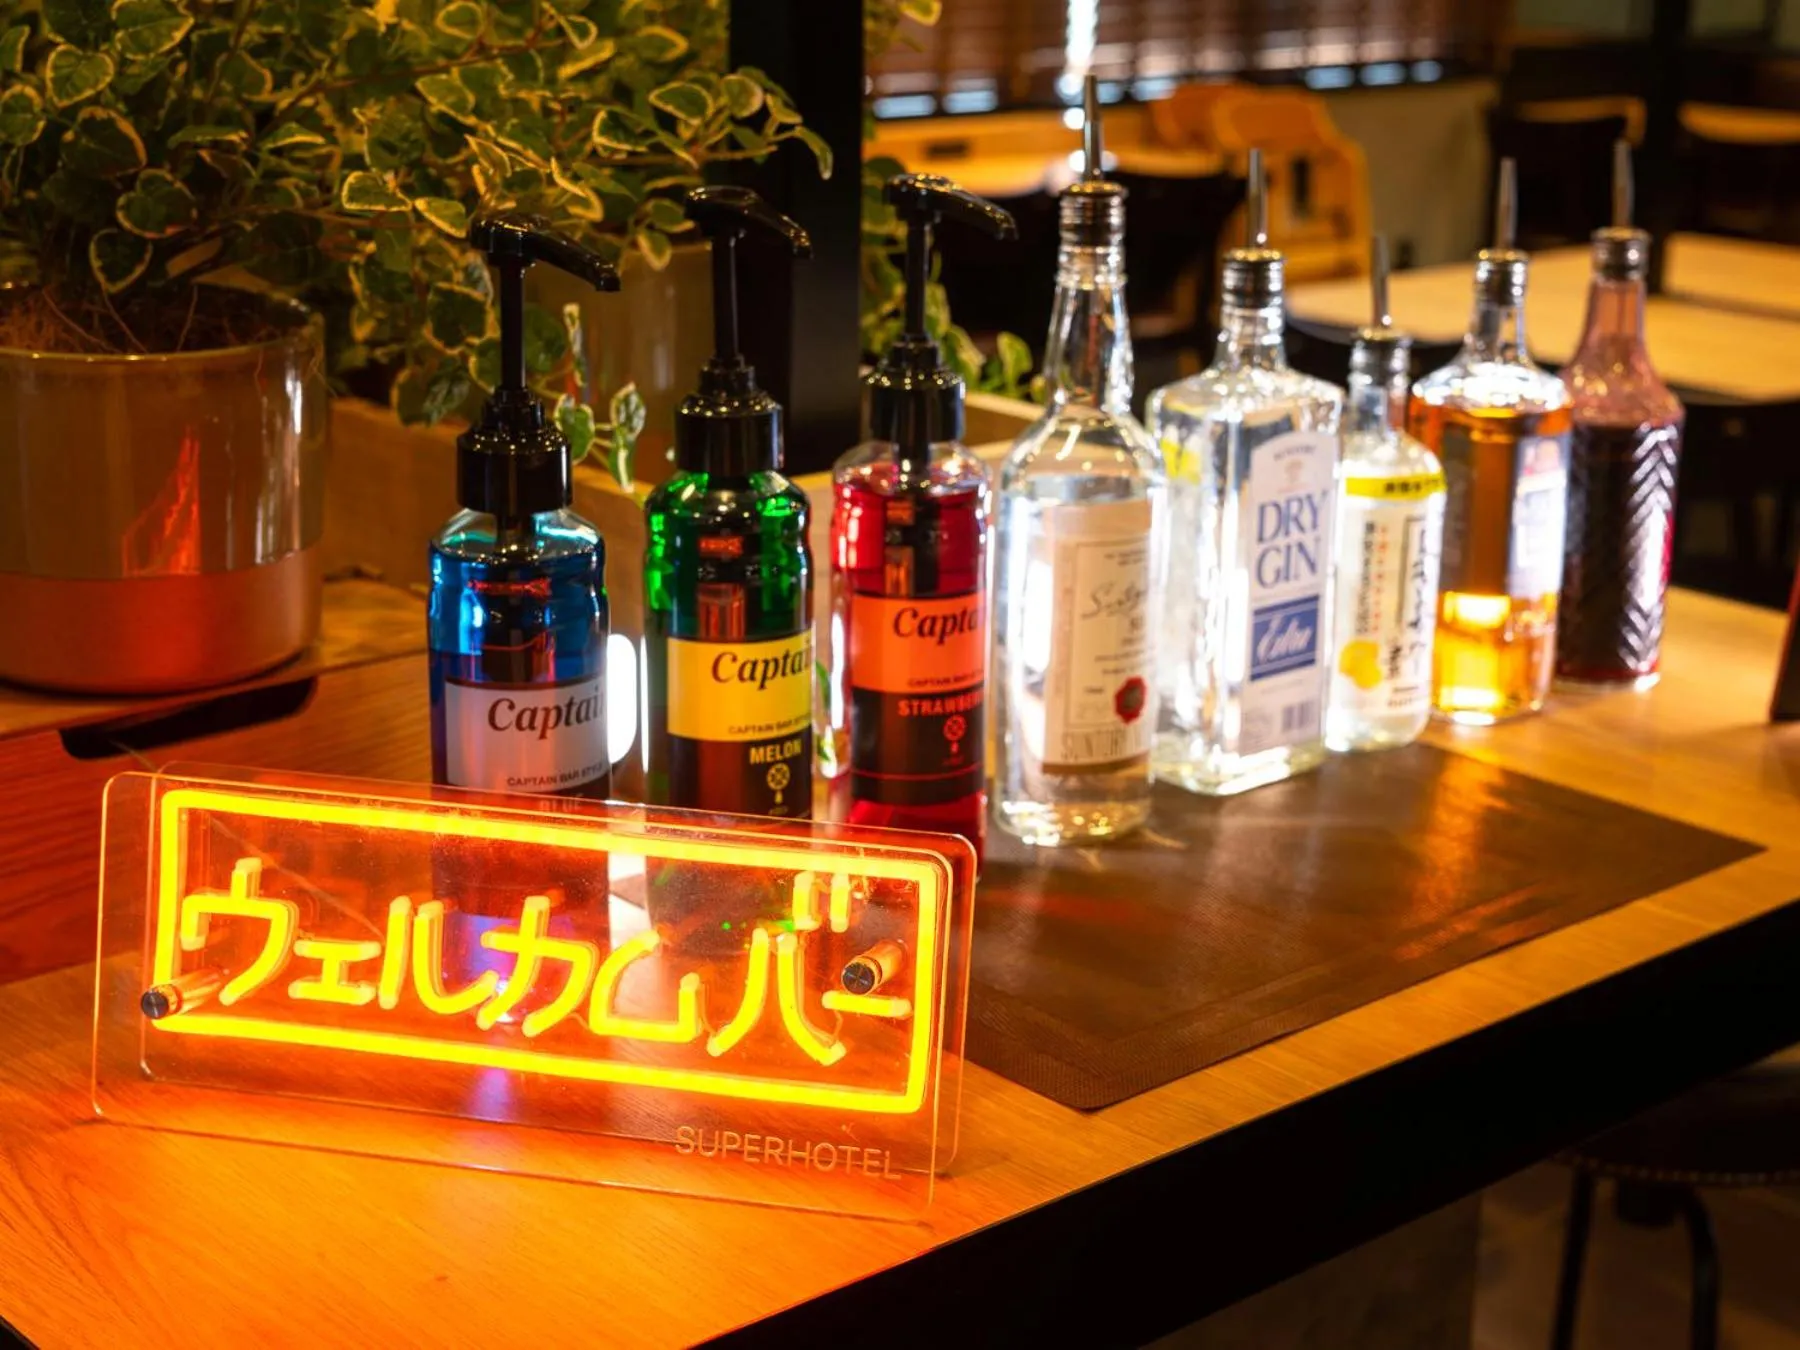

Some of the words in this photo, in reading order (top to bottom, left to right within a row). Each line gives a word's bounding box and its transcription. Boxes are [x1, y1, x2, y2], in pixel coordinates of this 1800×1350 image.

[1257, 489, 1329, 544] DRY
[1256, 536, 1321, 589] GIN
[749, 739, 802, 764] MELON
[507, 775, 558, 787] CAPTAIN
[179, 857, 913, 1067] ウェルカムバー
[675, 1125, 902, 1180] SUPERHOTEL
